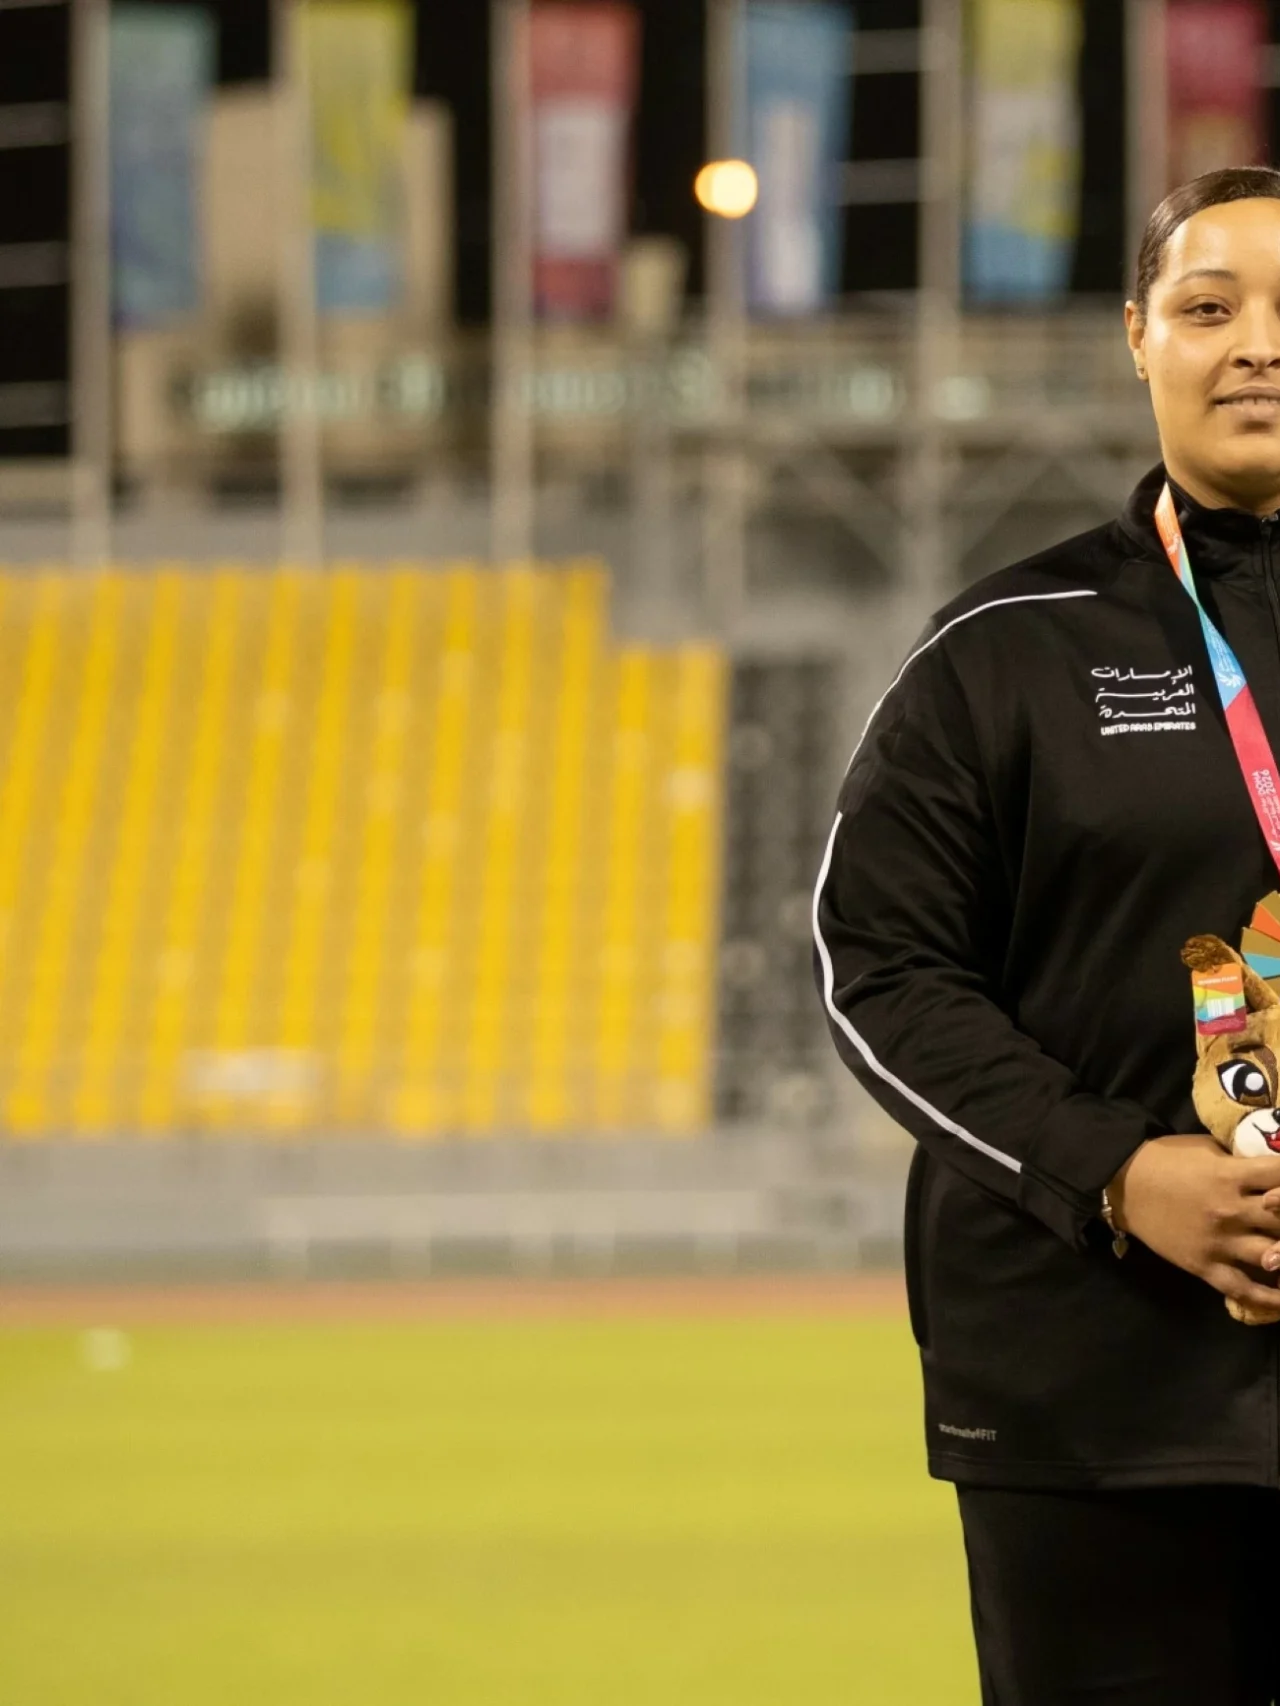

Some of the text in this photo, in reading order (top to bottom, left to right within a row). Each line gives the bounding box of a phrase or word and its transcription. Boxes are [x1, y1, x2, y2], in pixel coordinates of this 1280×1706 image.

[1101, 721, 1196, 736] UNITED ARAB EMIRATES
[1259, 769, 1276, 794] 2026
